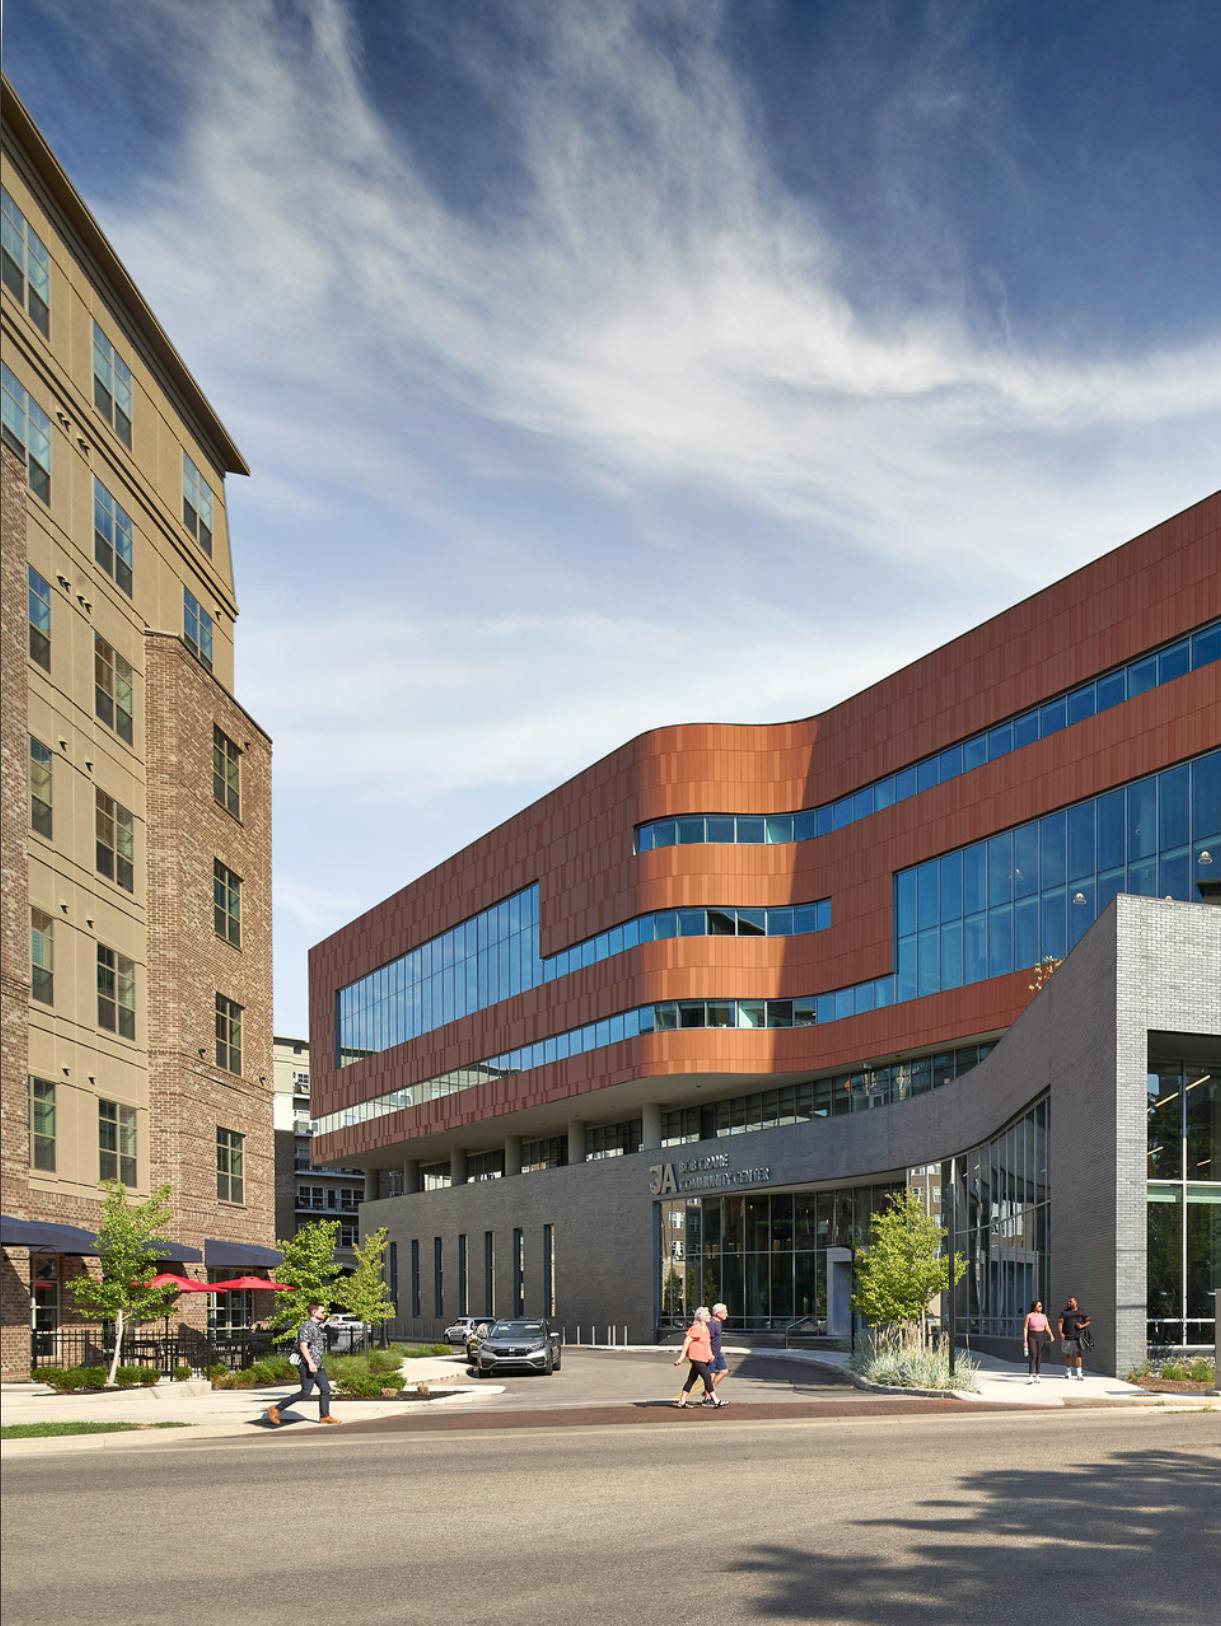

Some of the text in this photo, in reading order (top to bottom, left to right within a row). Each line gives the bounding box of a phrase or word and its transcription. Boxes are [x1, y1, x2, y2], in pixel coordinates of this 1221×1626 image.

[698, 1153, 730, 1171] CRANE
[679, 1167, 770, 1192] COMMUNITY CENTER
